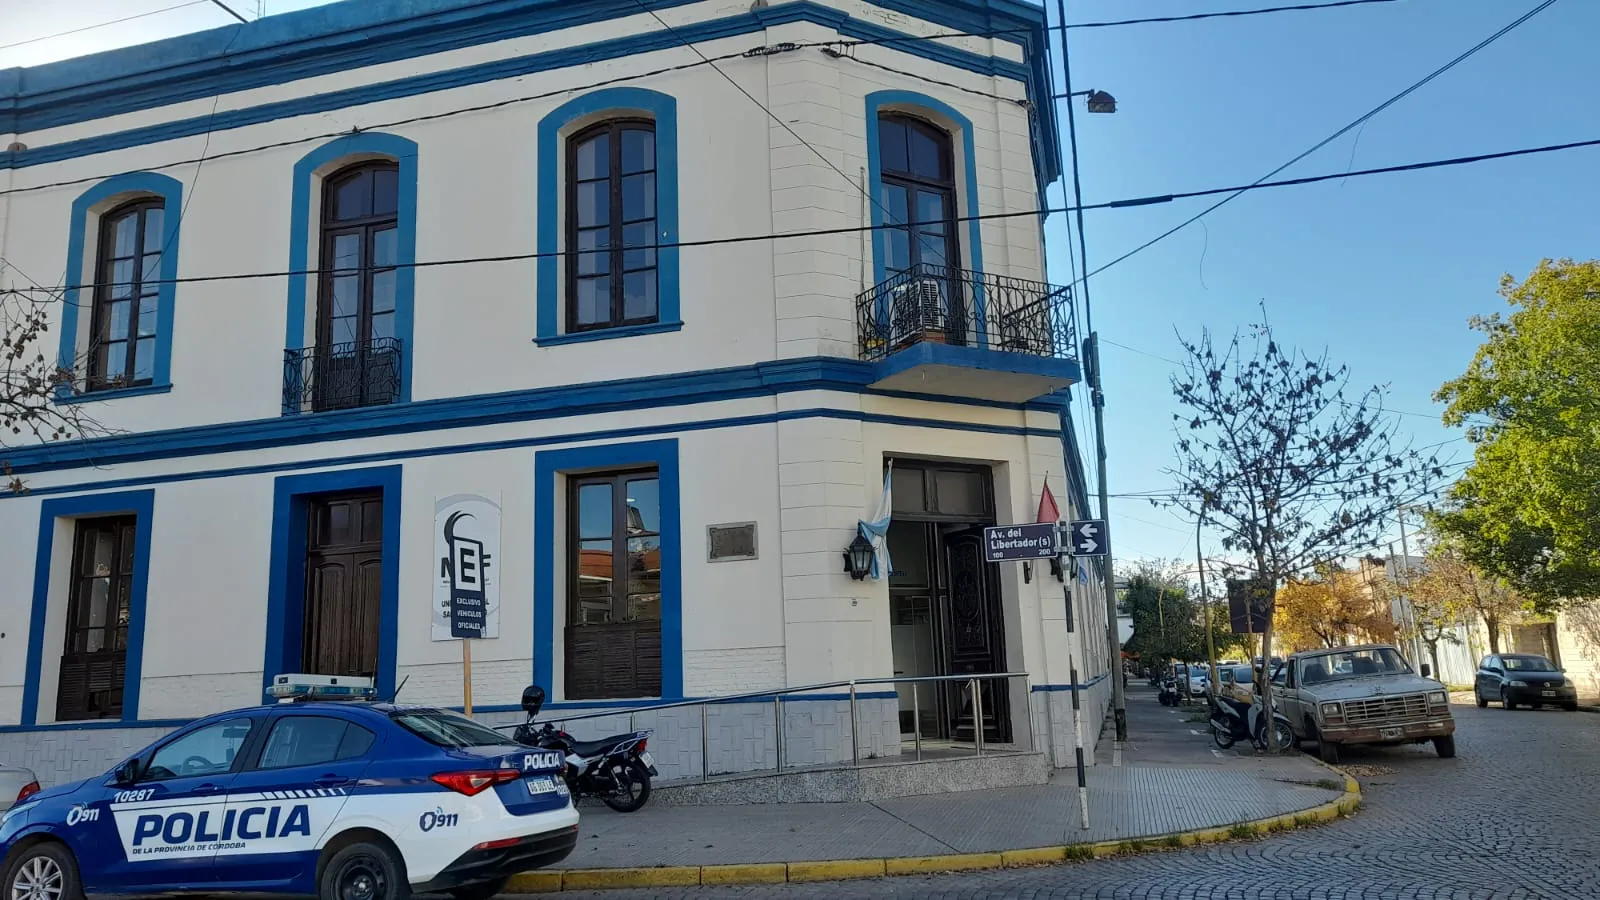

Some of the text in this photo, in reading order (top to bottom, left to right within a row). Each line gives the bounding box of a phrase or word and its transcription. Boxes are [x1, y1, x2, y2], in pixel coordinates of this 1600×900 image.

[991, 528, 1021, 539] Av. del
[460, 547, 476, 583] E
[456, 597, 481, 606] EXCLUSIVO
[457, 609, 482, 618] VEHICULOS
[457, 621, 481, 630] OFICIALES
[524, 752, 560, 770] POLICIA
[113, 788, 156, 803] 10287
[132, 804, 311, 846] POLICIA
[154, 845, 195, 853] PROVINCIA
[208, 842, 246, 850] CORDOBA
